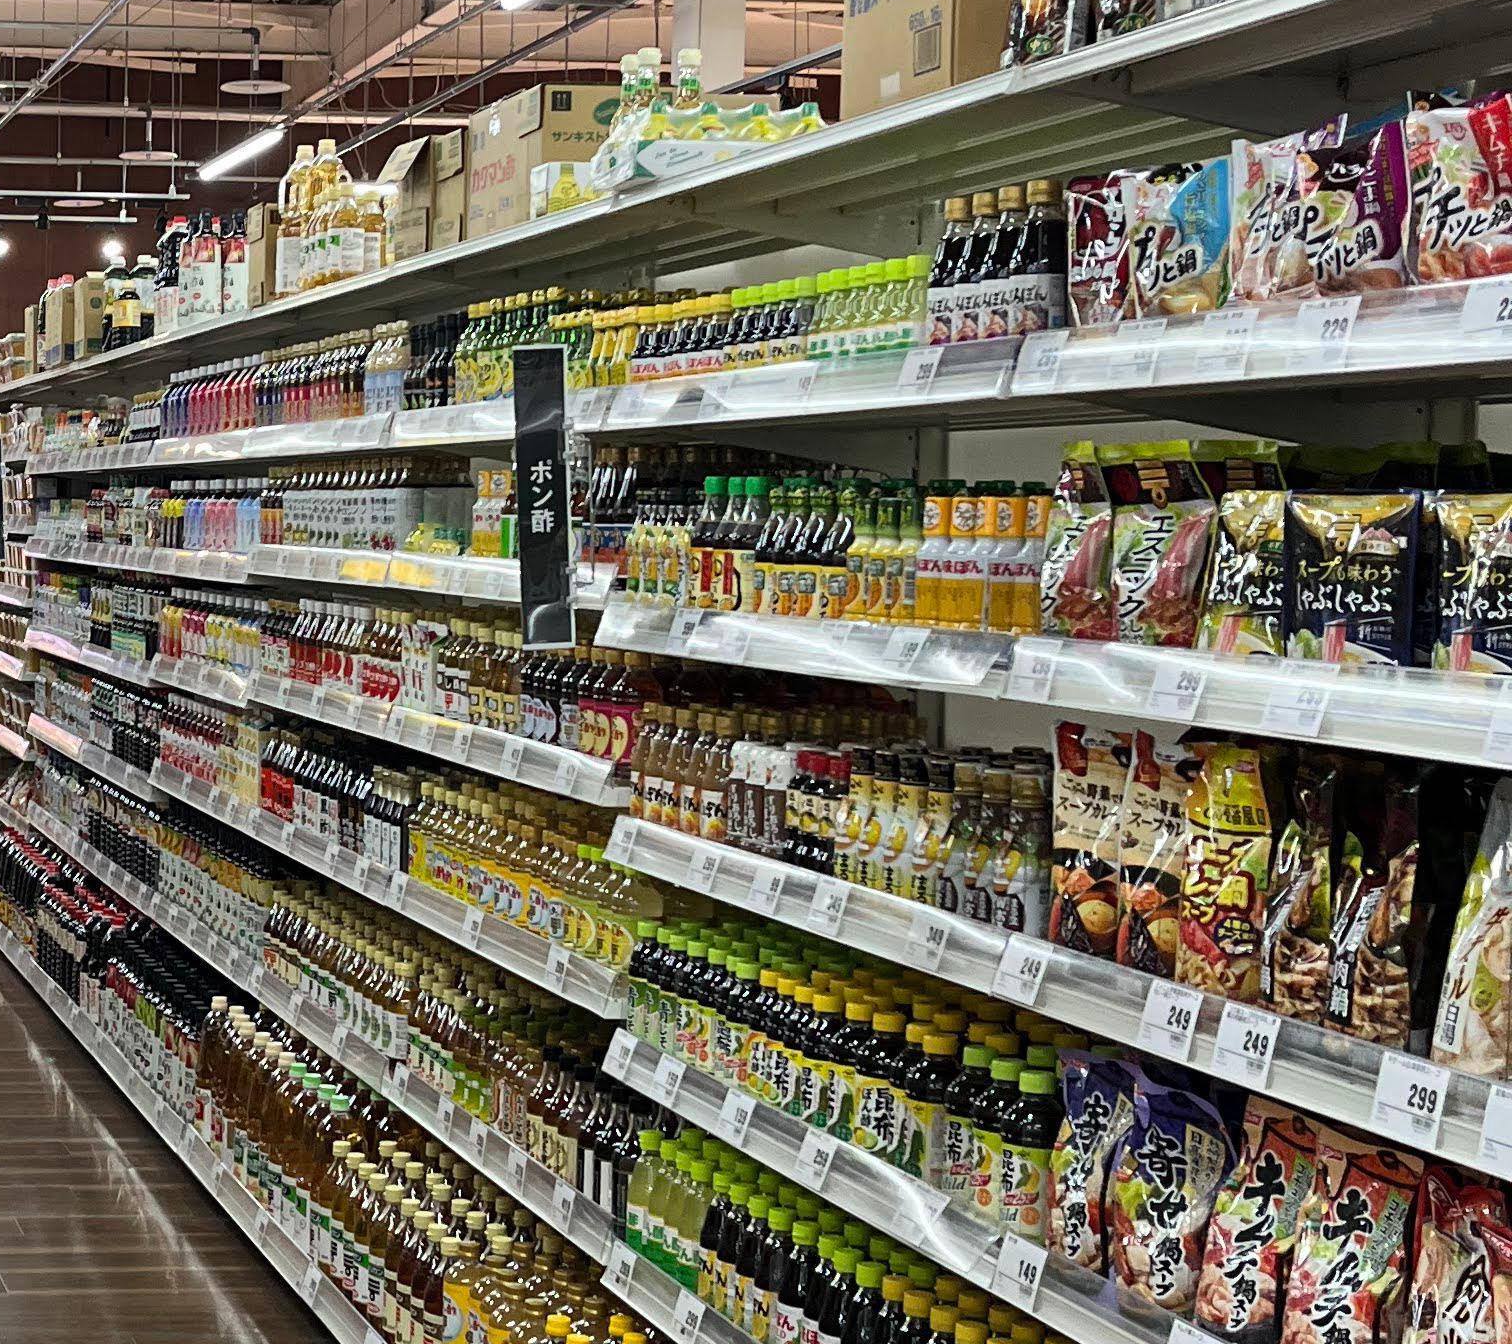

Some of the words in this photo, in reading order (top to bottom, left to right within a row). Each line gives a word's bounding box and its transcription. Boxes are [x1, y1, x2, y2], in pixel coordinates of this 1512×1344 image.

[530, 460, 554, 533] ポン酢
[1118, 514, 1175, 619] エスニック
[1020, 958, 1041, 979] 249
[1167, 1006, 1191, 1030] 249
[1244, 1031, 1268, 1056] 249
[873, 1086, 896, 1142] 昆布
[1409, 1083, 1437, 1114] 299
[1002, 1149, 1015, 1193] 昆布
[1136, 1127, 1190, 1300] 寄せ鍋スープ
[1019, 1260, 1037, 1284] 149
